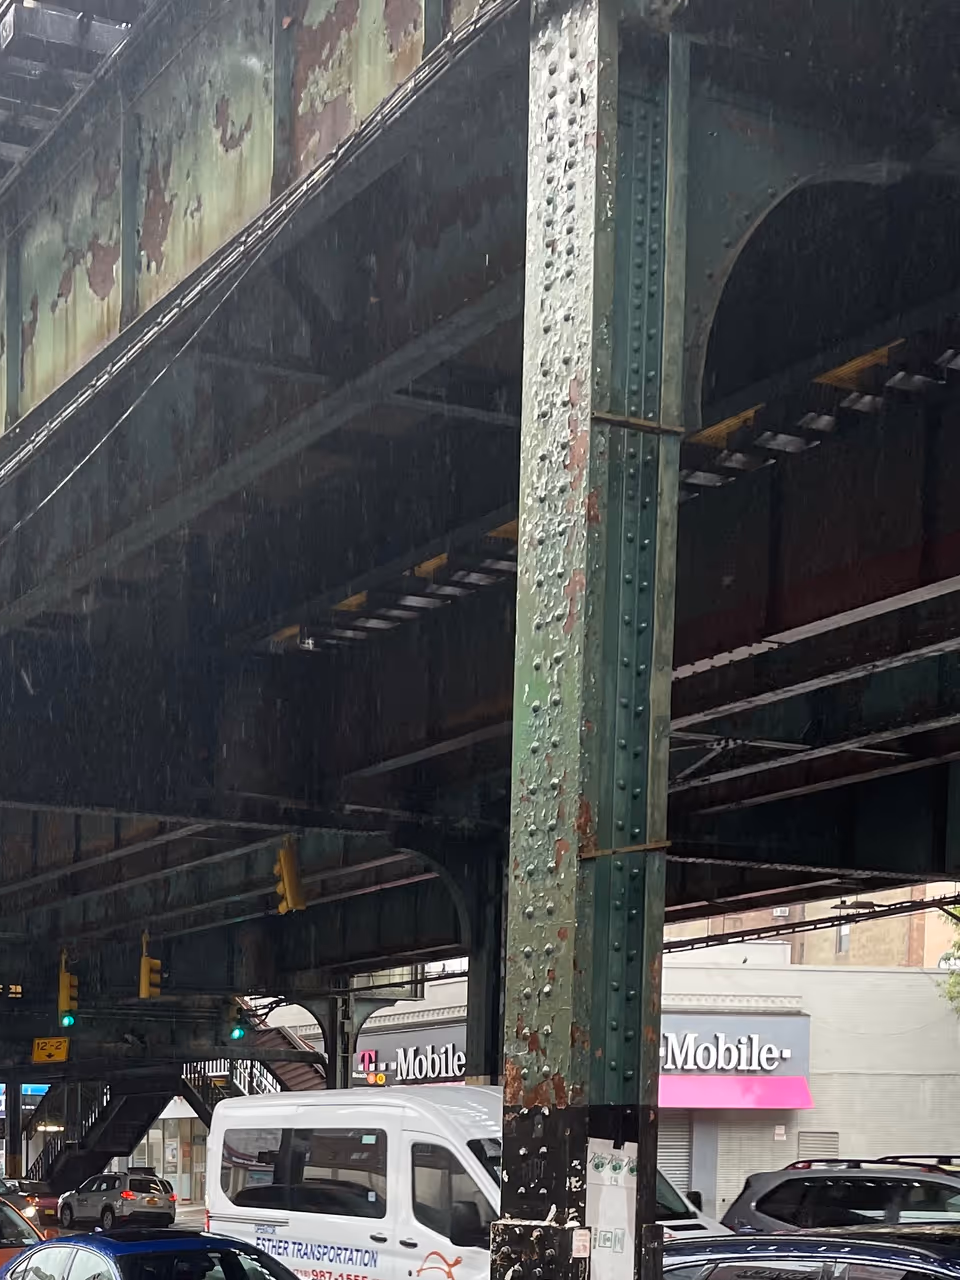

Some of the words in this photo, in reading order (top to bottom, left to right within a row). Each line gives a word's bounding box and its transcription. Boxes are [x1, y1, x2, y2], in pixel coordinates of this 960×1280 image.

[665, 1032, 781, 1071] Mobile
[255, 1236, 289, 1258] ESTHER
[291, 1241, 378, 1268] TRANSPORTATION
